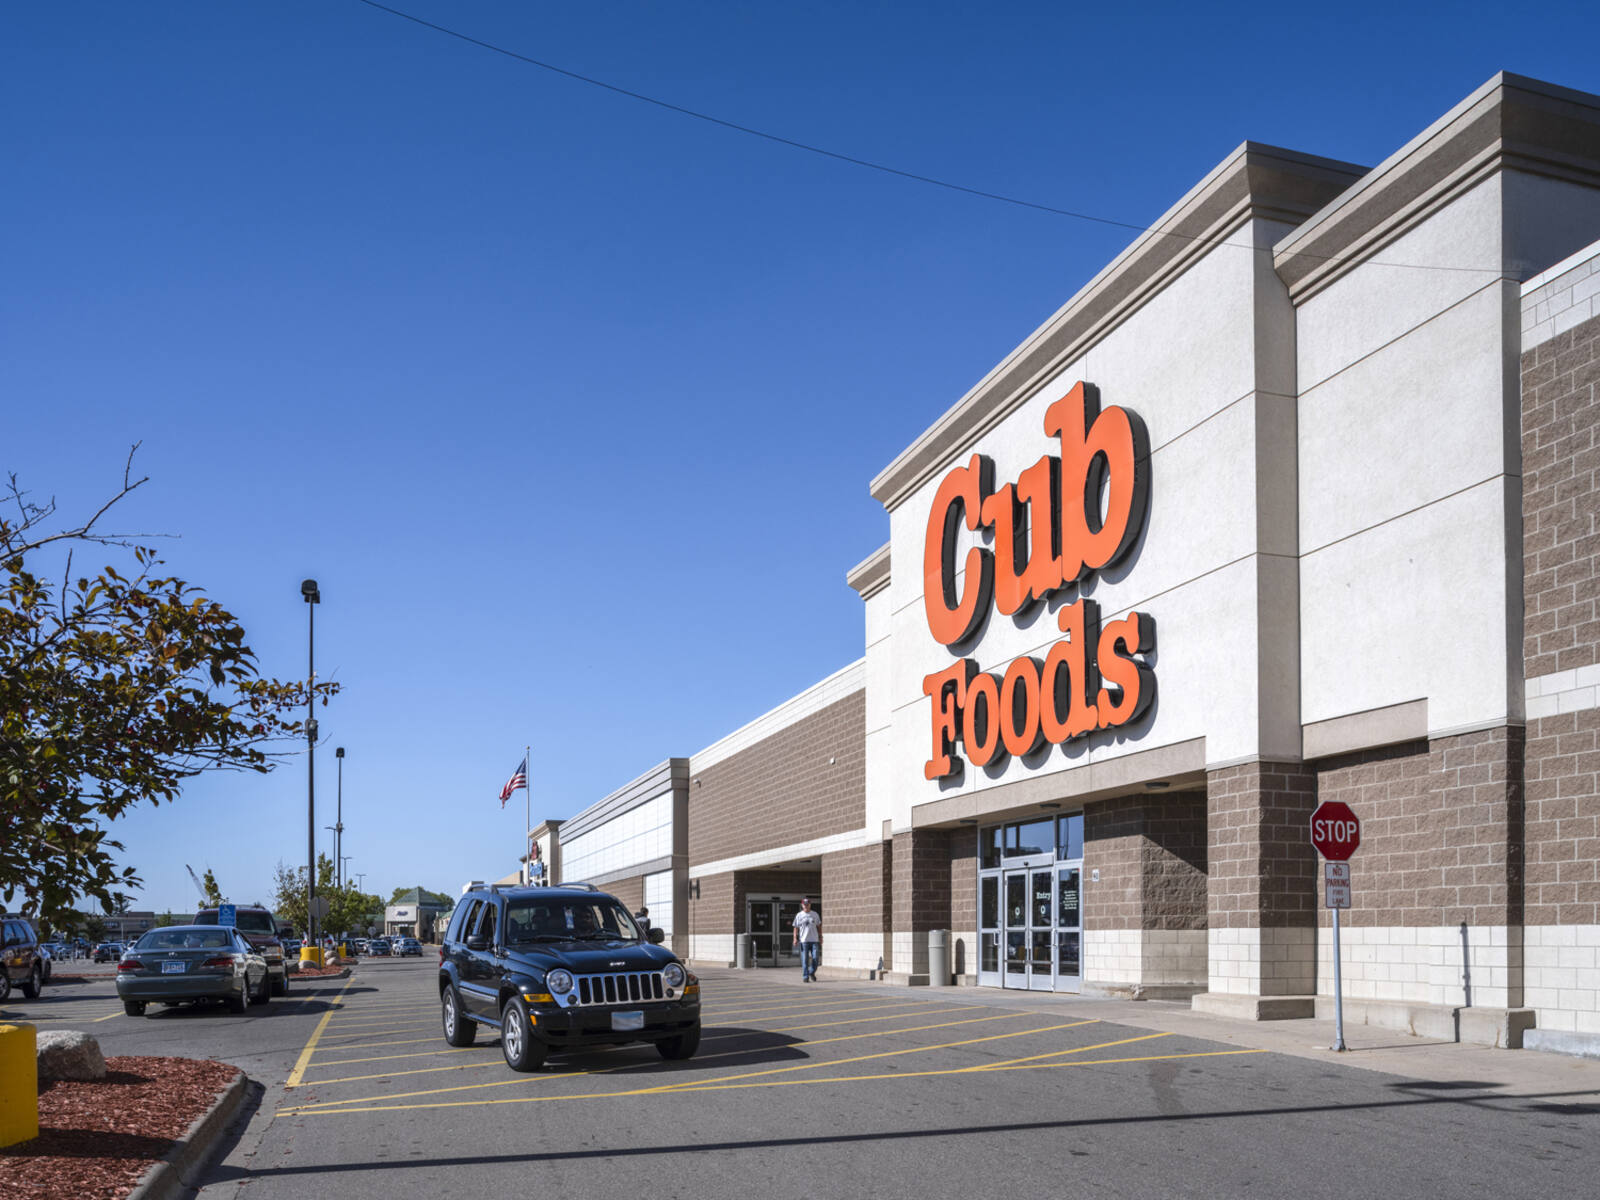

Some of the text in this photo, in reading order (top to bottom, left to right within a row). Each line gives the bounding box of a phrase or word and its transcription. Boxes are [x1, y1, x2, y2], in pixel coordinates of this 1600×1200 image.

[923, 380, 1146, 646] Cub
[922, 598, 1150, 780] Foods
[1315, 820, 1357, 843] STOP
[1332, 867, 1343, 876] NO
[1327, 879, 1349, 888] PARKING
[1036, 892, 1051, 901] Entry
